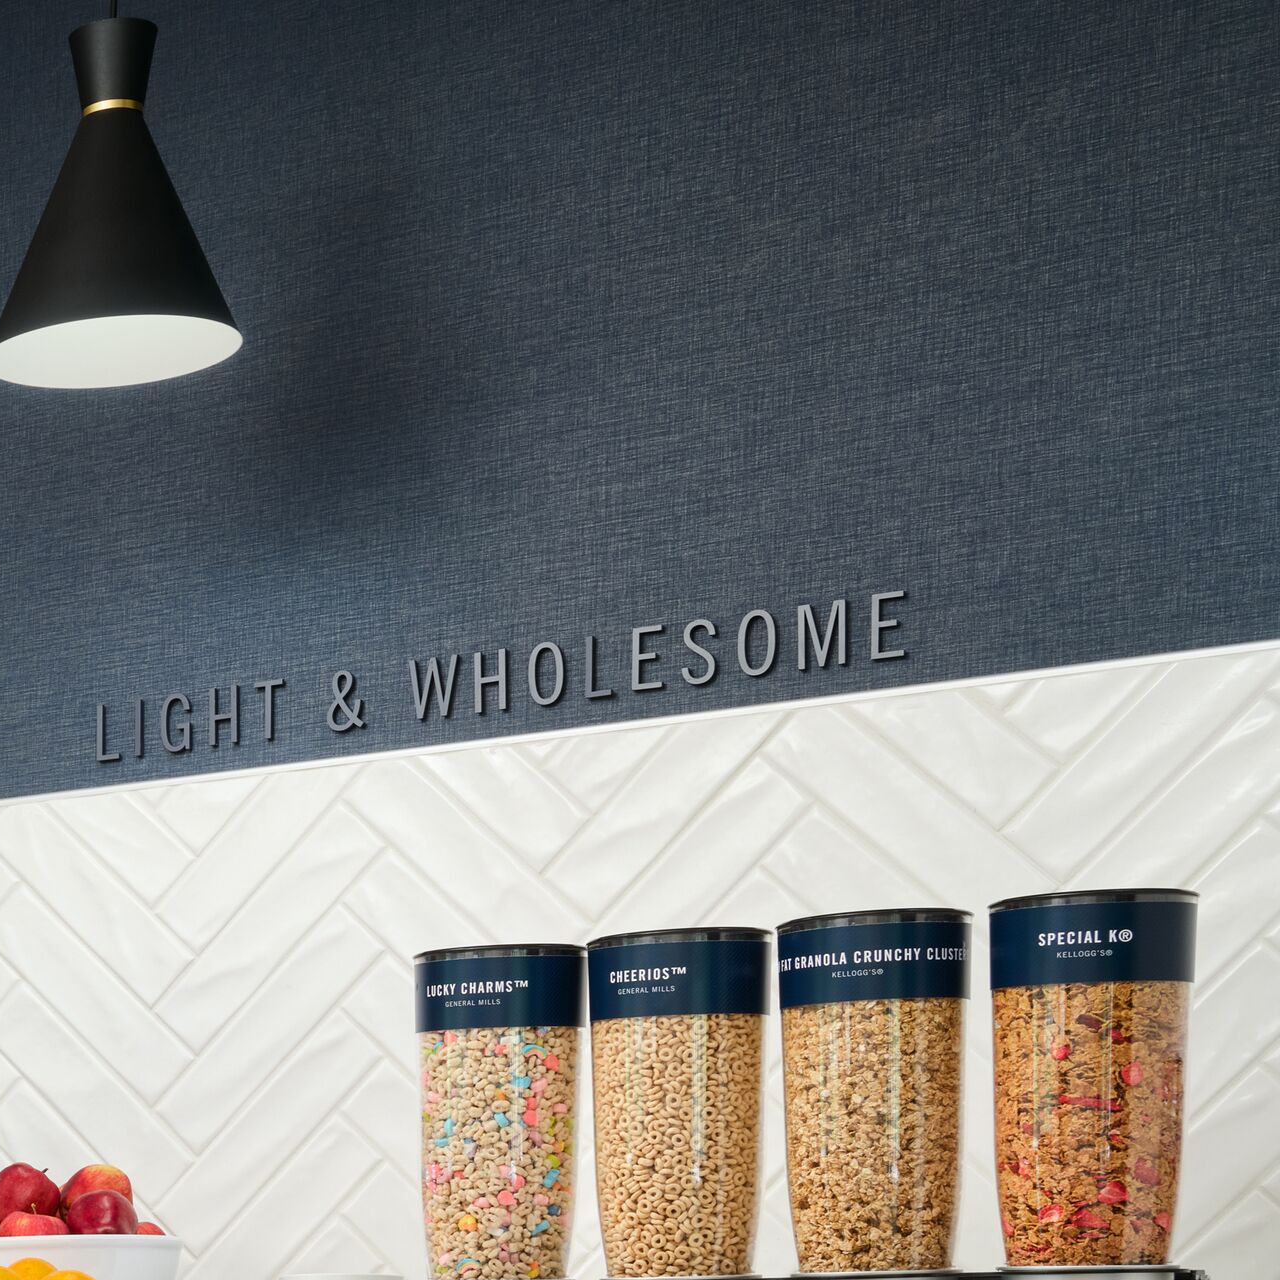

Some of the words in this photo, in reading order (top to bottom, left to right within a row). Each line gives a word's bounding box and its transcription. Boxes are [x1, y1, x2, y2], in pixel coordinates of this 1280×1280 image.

[95, 678, 285, 763] LIGHT
[326, 669, 366, 734] &
[408, 590, 905, 722] WHOLESOME
[1038, 929, 1102, 947] SPECIAL
[781, 958, 792, 973] FAT
[794, 951, 847, 970] GRANOLA
[853, 947, 921, 964] CRUNCHY
[426, 983, 456, 998] LUCKY
[617, 987, 649, 996] GENERAL
[651, 985, 676, 993] MILLS
[445, 1000, 475, 1008] GENERAL
[478, 998, 501, 1006] MILLS
